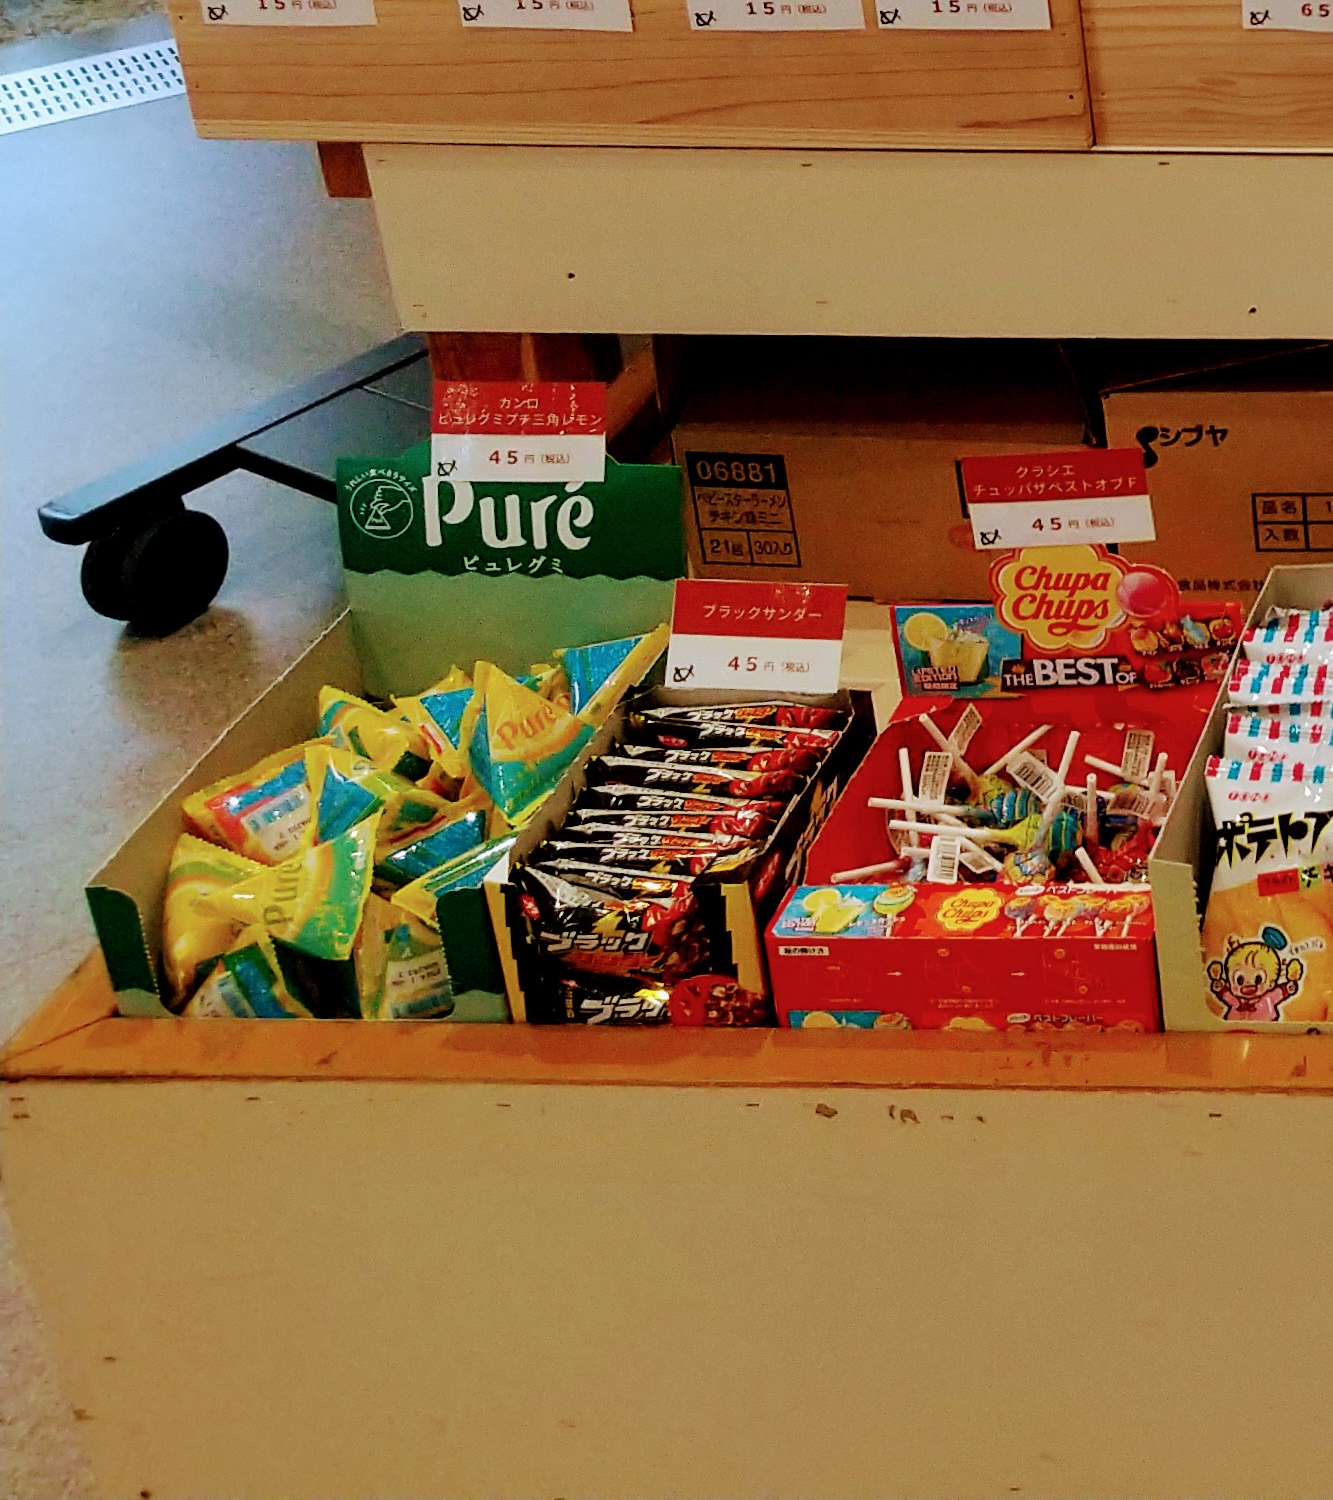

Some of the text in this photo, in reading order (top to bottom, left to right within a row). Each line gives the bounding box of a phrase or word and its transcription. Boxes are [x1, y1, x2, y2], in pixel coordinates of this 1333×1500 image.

[500, 396, 540, 410] カンロ
[437, 412, 604, 427] ピュレグミプチ三角レモン
[696, 460, 777, 483] 06881
[1015, 464, 1076, 478] クラシエ
[972, 476, 1139, 497] チュッパザベストオブF
[422, 475, 595, 551] Puré
[1261, 500, 1299, 516] 品名
[1264, 527, 1301, 542] 入数
[463, 555, 564, 575] ピュレグミ
[1013, 565, 1111, 601] Chupa
[702, 603, 822, 621] ブラックサンダー
[1012, 593, 1112, 637] Chups
[1003, 657, 1138, 688] THE BEST OF
[700, 722, 747, 739] ブラック
[664, 749, 712, 764] ブラック
[644, 768, 694, 783] ブラック
[622, 813, 671, 828] ブラック
[541, 930, 650, 952] ブラック
